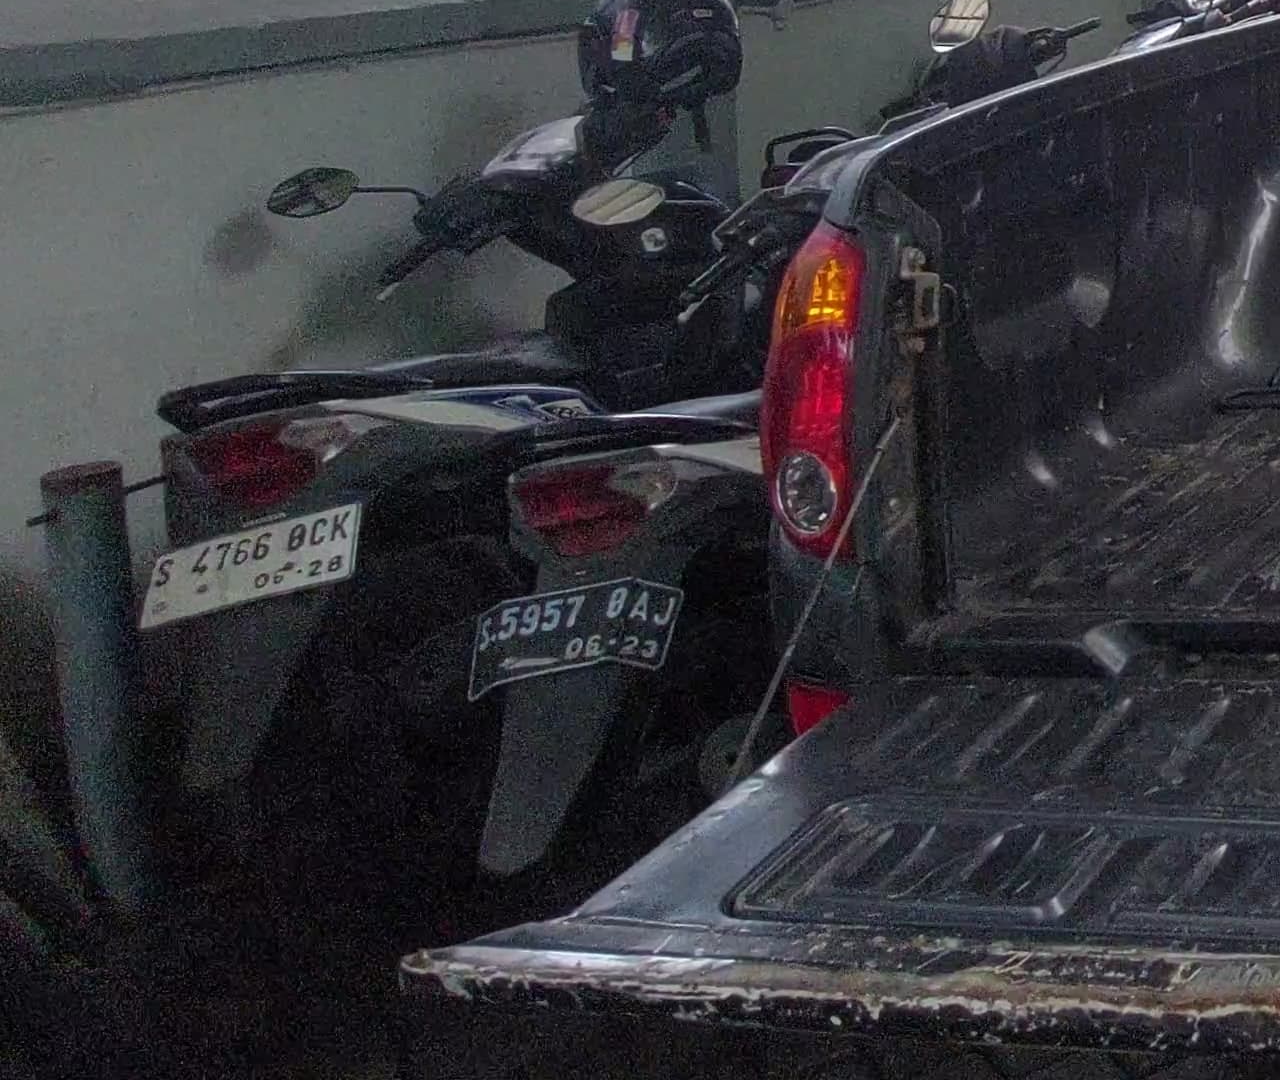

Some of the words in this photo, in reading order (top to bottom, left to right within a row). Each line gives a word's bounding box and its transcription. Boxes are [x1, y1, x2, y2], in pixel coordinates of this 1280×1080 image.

[156, 558, 174, 587] S
[192, 532, 272, 574] 4766
[287, 510, 349, 551] BCK
[606, 587, 676, 625] BAJ
